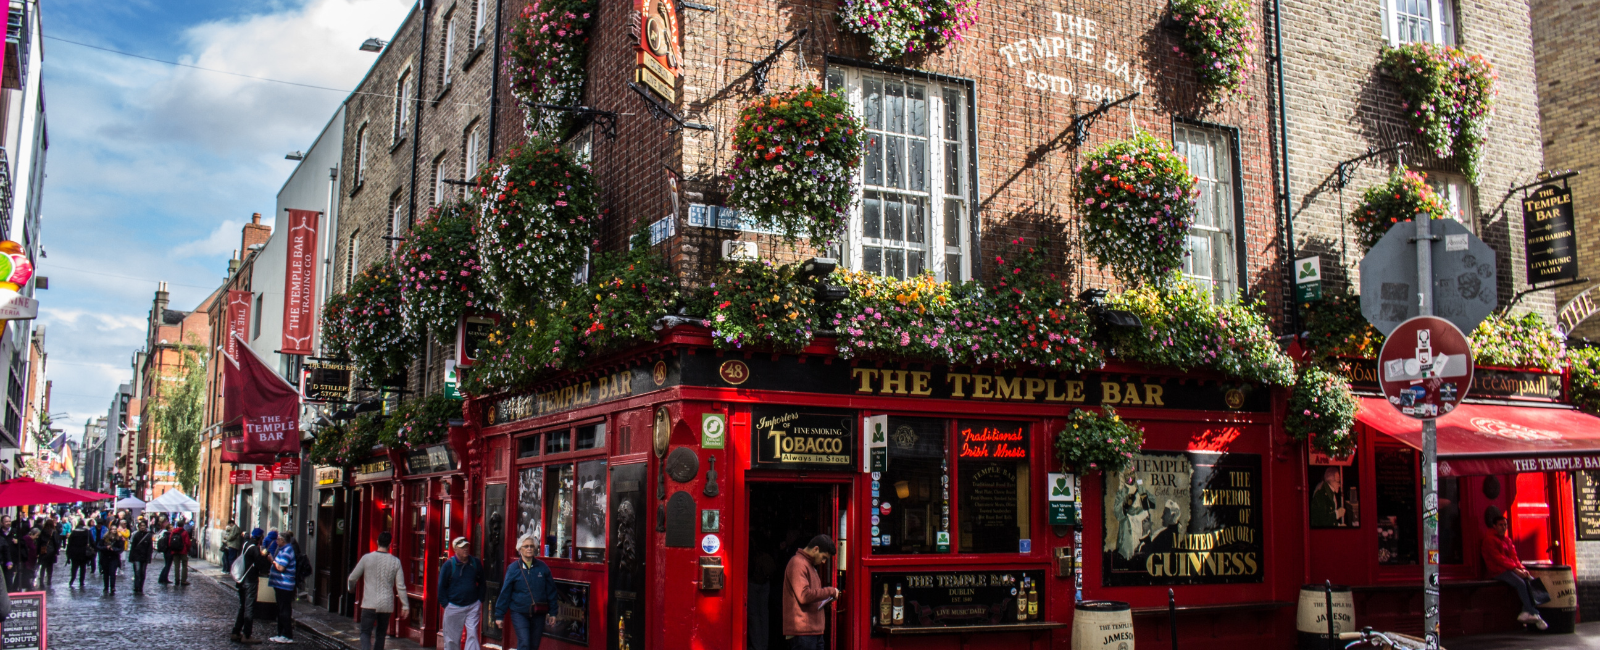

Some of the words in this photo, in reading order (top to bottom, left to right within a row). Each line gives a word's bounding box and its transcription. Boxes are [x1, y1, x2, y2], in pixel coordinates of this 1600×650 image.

[1052, 11, 1098, 41] THE
[999, 36, 1095, 68] TEMPLE
[1103, 50, 1148, 95] BAR
[1025, 69, 1077, 96] ESTD.
[1083, 83, 1124, 103] 1840
[1538, 188, 1555, 199] THE
[1524, 193, 1571, 212] TEMPLE
[1535, 208, 1562, 222] BAR
[1528, 235, 1545, 245] BEER
[1544, 229, 1572, 242] GARDEN
[293, 235, 304, 258] BAR
[304, 252, 312, 268] CO.
[1531, 261, 1548, 269] LIVE
[1548, 255, 1572, 266] MUSIC
[1540, 265, 1562, 275] DAILY
[290, 260, 303, 306] TEMPLE
[302, 269, 311, 315] TRADING
[237, 308, 246, 326] THE
[1560, 291, 1597, 330] THE
[289, 307, 299, 331] THE
[228, 319, 237, 353] TRDING
[322, 363, 344, 371] TEMPLE
[655, 362, 665, 381] 48
[725, 362, 744, 379] 48
[537, 381, 592, 414] TEMPLE
[598, 370, 633, 400] BAR
[852, 367, 933, 396] THE
[946, 372, 1086, 402] TEMPLE
[1101, 381, 1165, 406] BAR
[260, 415, 281, 423] THE
[756, 412, 799, 430] Importers
[246, 421, 294, 433] TEMPLE
[793, 427, 810, 435] FINE
[810, 428, 842, 436] SMOKING
[961, 427, 1023, 442] Traditional
[259, 431, 284, 441] BAR
[767, 430, 843, 459] TOBACCO
[960, 443, 989, 457] Irish
[993, 443, 1026, 457] Music
[783, 454, 812, 463] Always
[815, 454, 823, 462] in
[826, 455, 849, 463] Stock
[1513, 459, 1537, 471] THE
[1538, 457, 1582, 470] TEMPLE
[973, 466, 1001, 481] TEMPLE
[1002, 468, 1016, 482] BAR
[1132, 460, 1189, 473] TEMPLE
[1151, 473, 1177, 487] BAR
[1229, 471, 1251, 487] THE
[1202, 488, 1251, 506] EMPEROR
[1239, 508, 1251, 524] OF
[1172, 532, 1214, 550] MALTED
[1214, 525, 1256, 547] LIQUORS
[1146, 552, 1258, 577] GUINNESS
[906, 574, 933, 588] THE
[936, 574, 987, 587] TEMPLE
[990, 573, 1016, 586] BAR
[949, 588, 975, 596] DUBLIN
[6, 610, 38, 619] OFFEE
[951, 608, 968, 616] MUSIC
[969, 607, 987, 615] DAILY
[1315, 612, 1352, 624] JAESON
[4, 635, 38, 644] DONUTS
[1103, 631, 1134, 646] JAMESO
